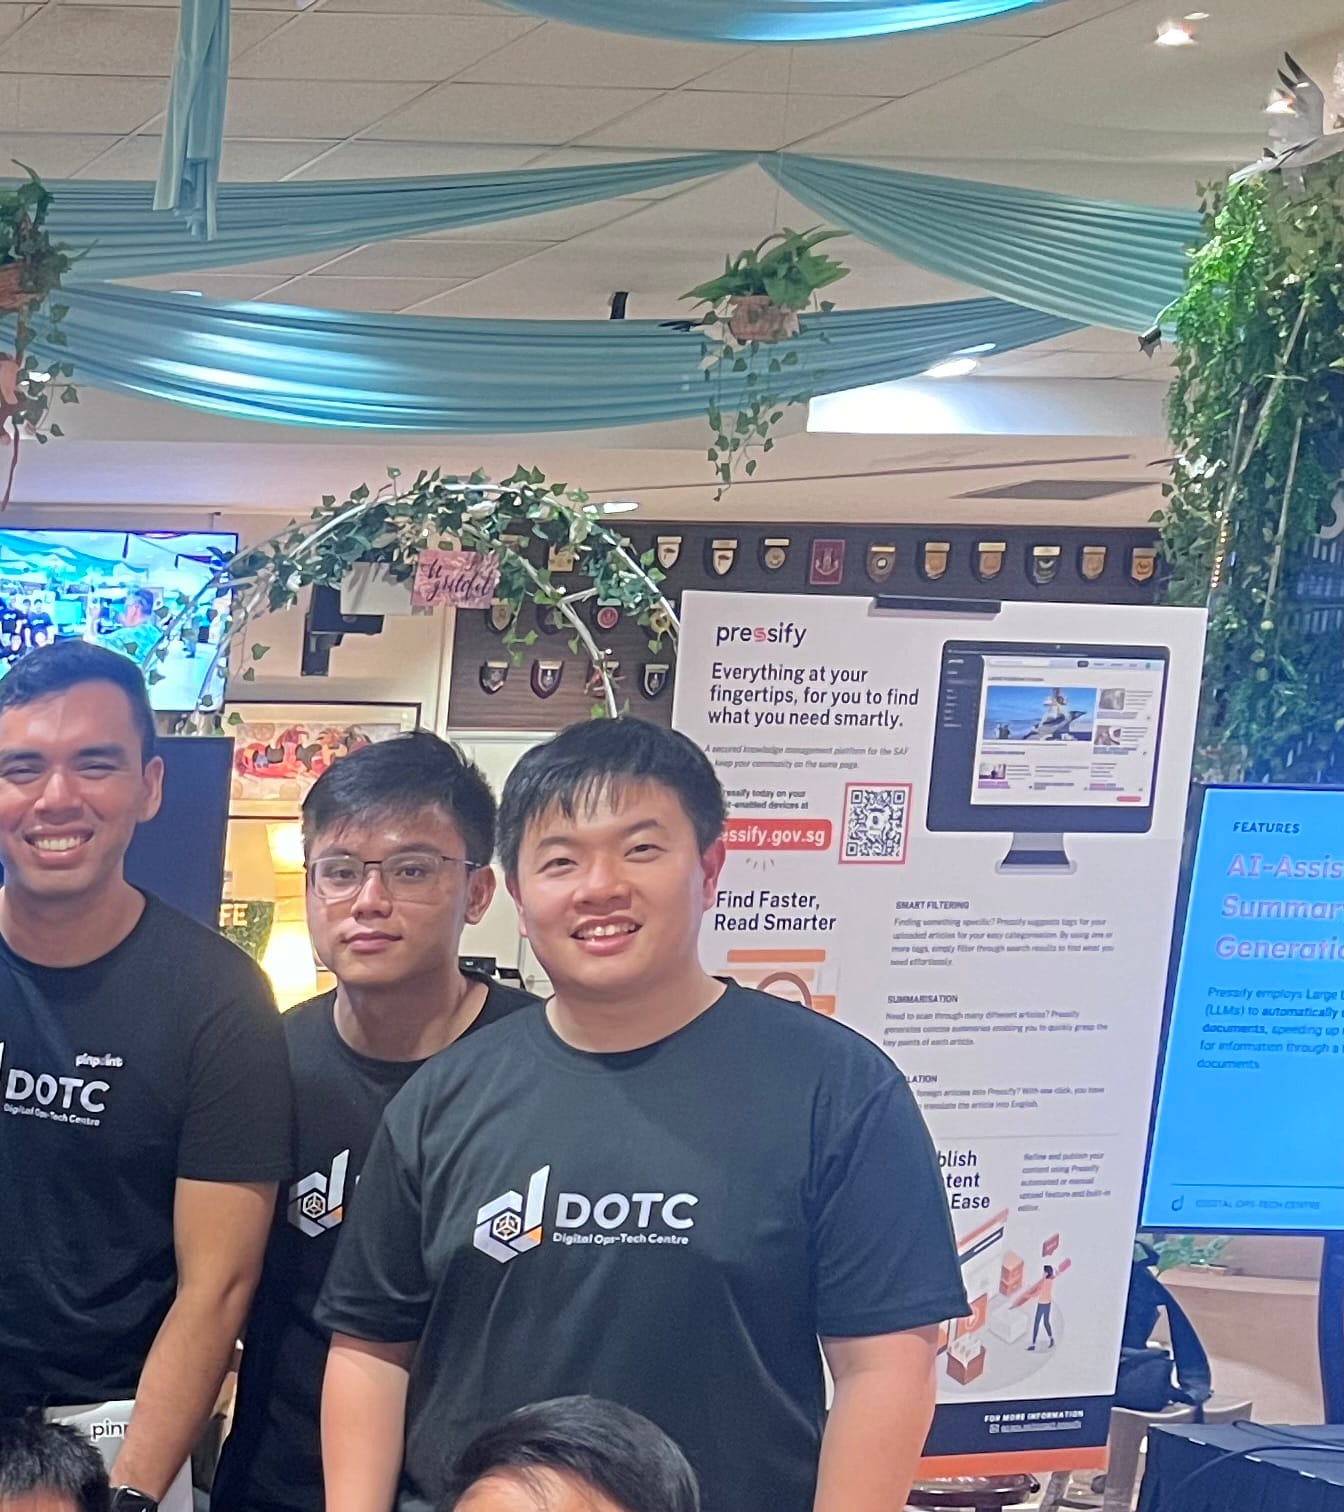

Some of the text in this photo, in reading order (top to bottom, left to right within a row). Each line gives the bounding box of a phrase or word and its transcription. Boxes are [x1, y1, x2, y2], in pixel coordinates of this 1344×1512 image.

[716, 622, 807, 648] pressify
[712, 662, 869, 685] Everything at your
[710, 684, 920, 707] fingertips, for you to find
[708, 706, 904, 730] what you need smartly.
[752, 789, 806, 799] today on your
[768, 801, 809, 809] devices at
[1233, 821, 1301, 834] FEATURES
[716, 890, 820, 911] Find Faster,
[714, 913, 837, 931] Read Smarter
[1306, 988, 1338, 1002] Large
[1248, 1006, 1259, 1016] to
[1262, 1007, 1338, 1019] automatically
[1326, 1026, 1339, 1036] up
[5, 1069, 110, 1113] DOTC
[4, 1103, 34, 1115] Digital
[69, 1114, 100, 1126] Centre
[946, 1172, 981, 1189] tent
[951, 1193, 990, 1210] Ease
[555, 1193, 698, 1229] DOTC
[552, 1232, 689, 1246] Digital Ops-Tech Centre
